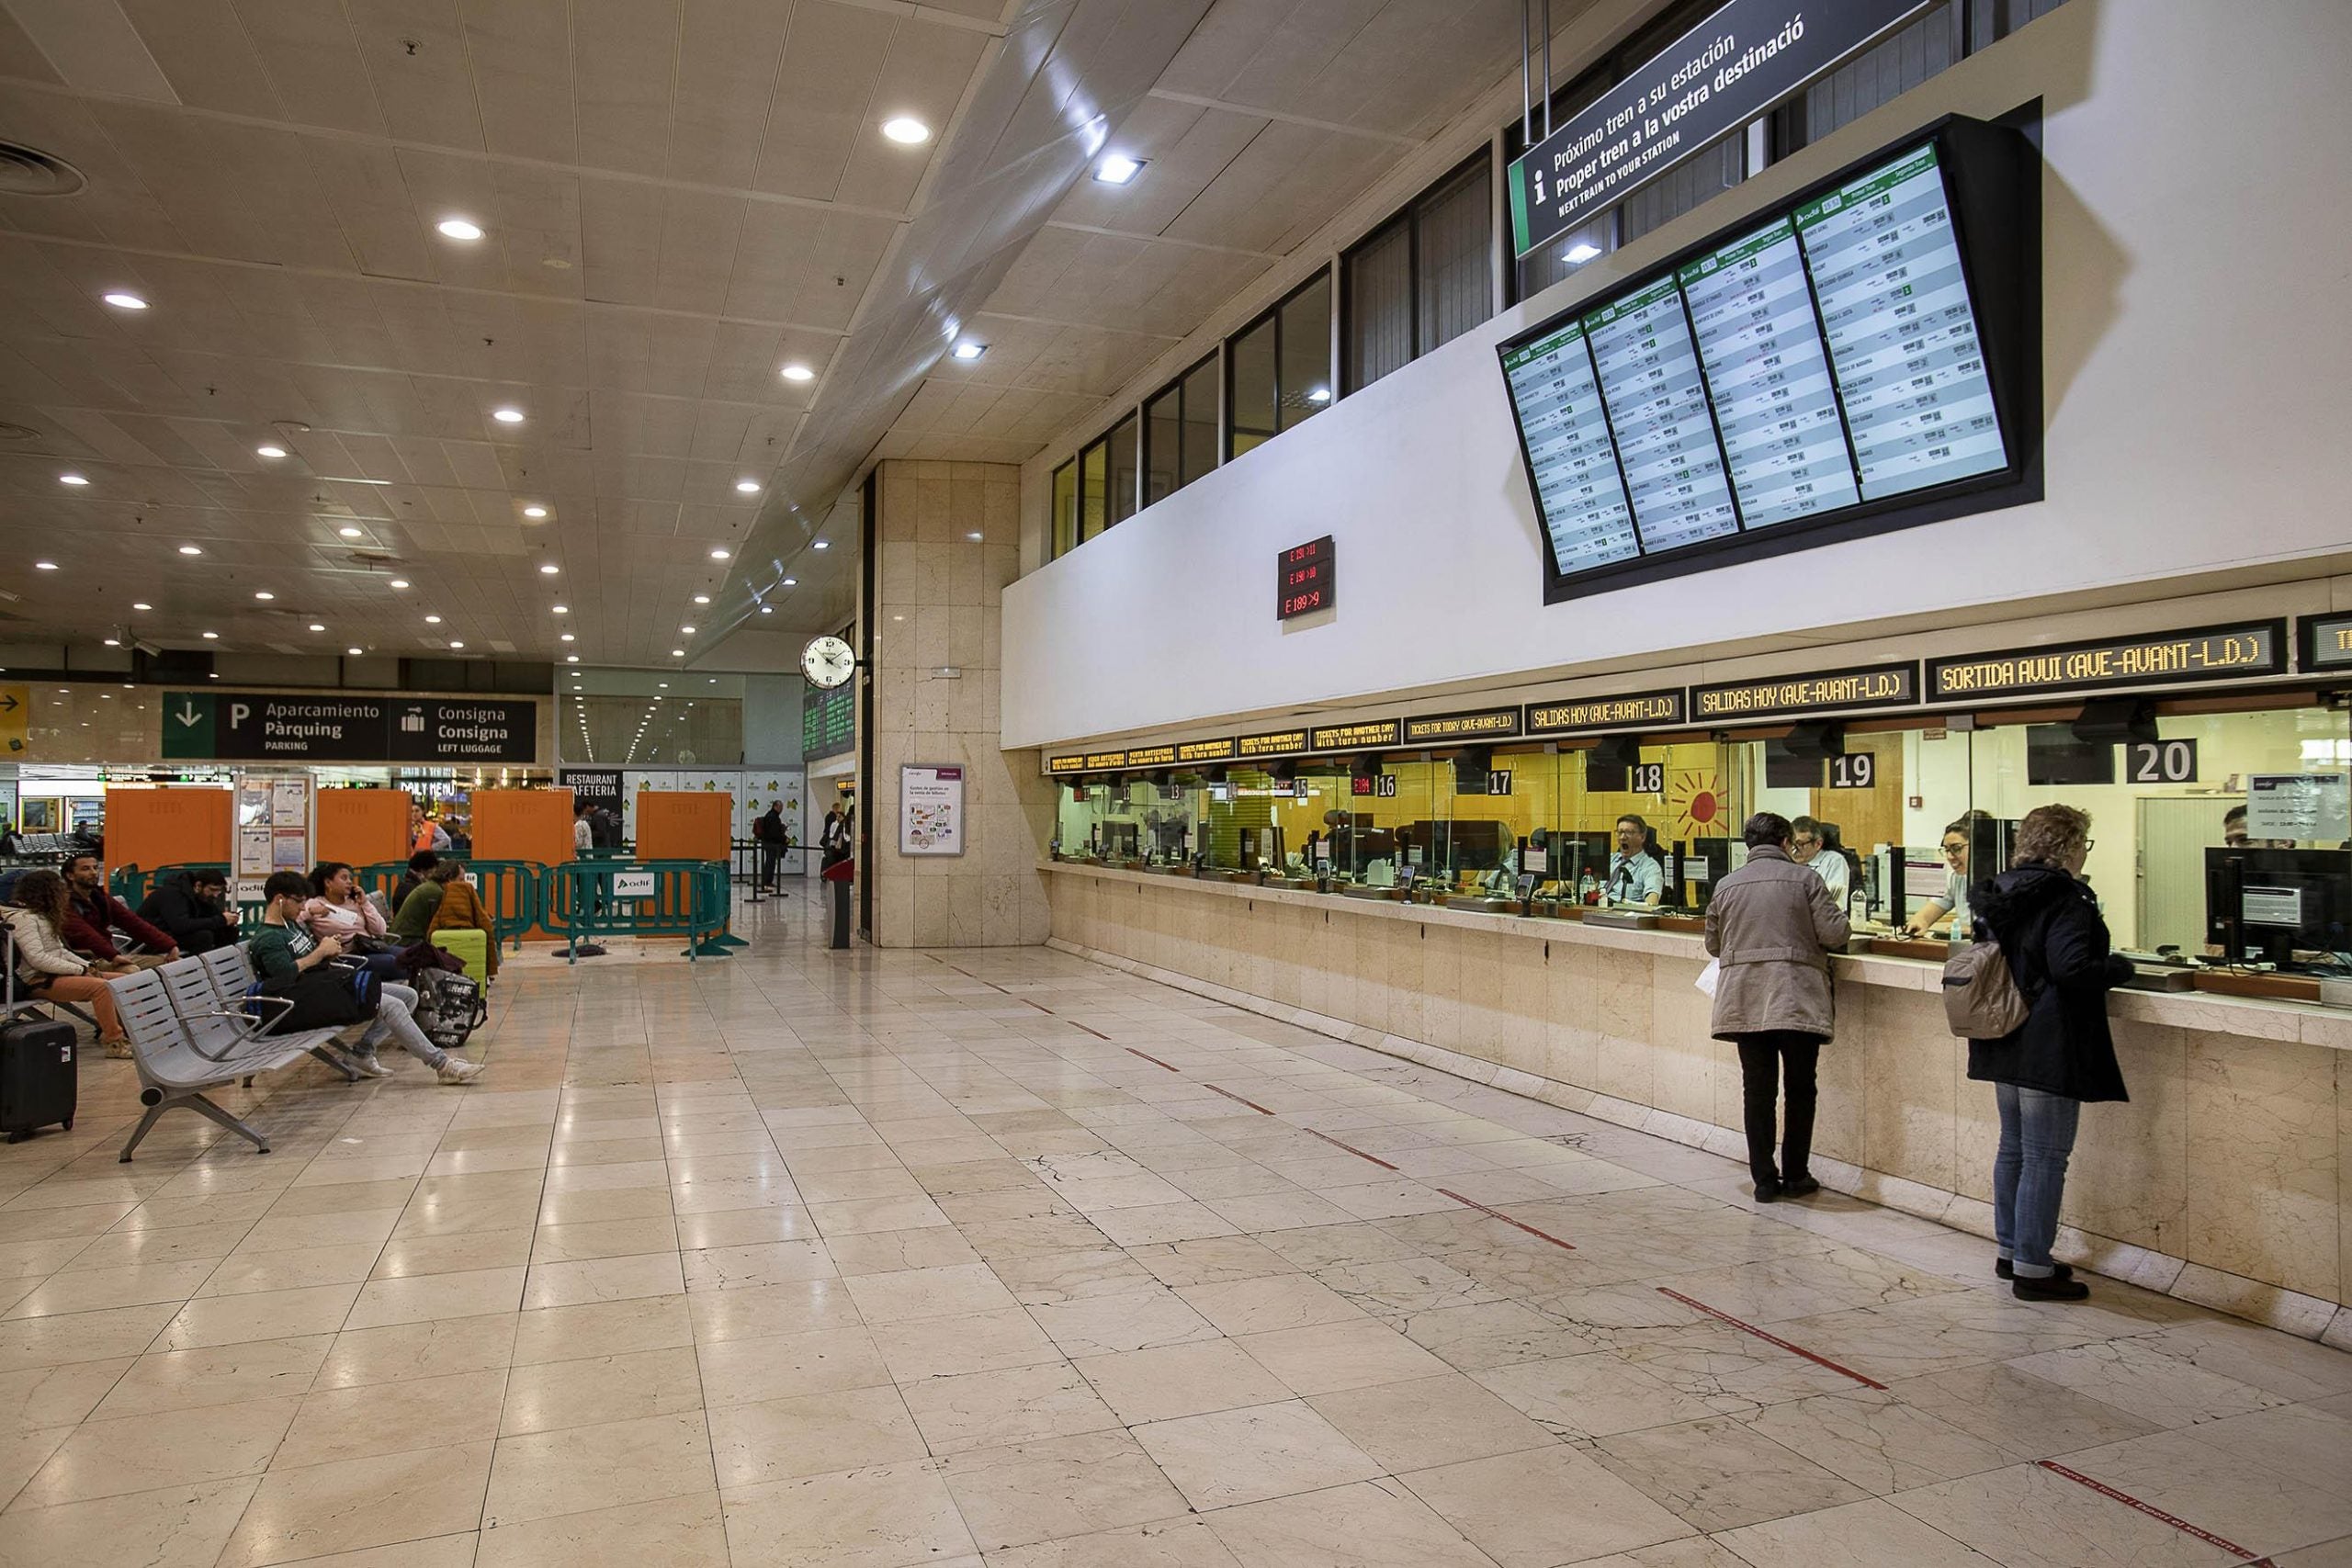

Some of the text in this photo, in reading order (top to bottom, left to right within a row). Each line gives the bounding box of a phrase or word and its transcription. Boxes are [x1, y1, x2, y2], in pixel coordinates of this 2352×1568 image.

[1554, 32, 1736, 172] Próximo tren a su estación
[1555, 13, 1804, 198] Proper tren a la vostra destinació
[1558, 130, 1680, 218] NEXT TRAIN TO YOUR STATION
[1285, 599, 1292, 614] E
[1942, 636, 2258, 691] SORTIDA AVUI (AVE-AVANT-L.D.)
[1703, 674, 1900, 712] SALIDAS HOY (AVE-AVANT-L.D.)
[231, 704, 250, 729] P
[266, 703, 379, 721] Aparcamiento
[438, 706, 505, 723] Consigna
[1534, 709, 1569, 728] SALIDAS
[1571, 706, 1588, 723] HOY
[266, 720, 343, 739] Pàrquing
[438, 725, 508, 741] Consigna
[1316, 723, 1395, 739] TICKETS FOR ANOTHER DAY
[1430, 722, 1442, 733] FOR
[266, 741, 309, 751] PARKING
[438, 743, 502, 755] LEFT LUGGAGE
[1316, 734, 1394, 748] With turn number
[1836, 754, 1871, 786] 19
[2136, 741, 2191, 782] 20
[567, 774, 617, 785] RESTAURANT
[1379, 776, 1394, 796] 16
[1490, 772, 1509, 795] 17
[1635, 765, 1661, 792] 18
[401, 783, 455, 796] DAILY MENU
[571, 785, 616, 797] AFETERIA
[1170, 784, 1180, 799] 13
[1295, 780, 1306, 797] 15
[629, 879, 650, 887] adif
[2098, 1486, 2128, 1501] turno
[2209, 1536, 2235, 1551] torn
